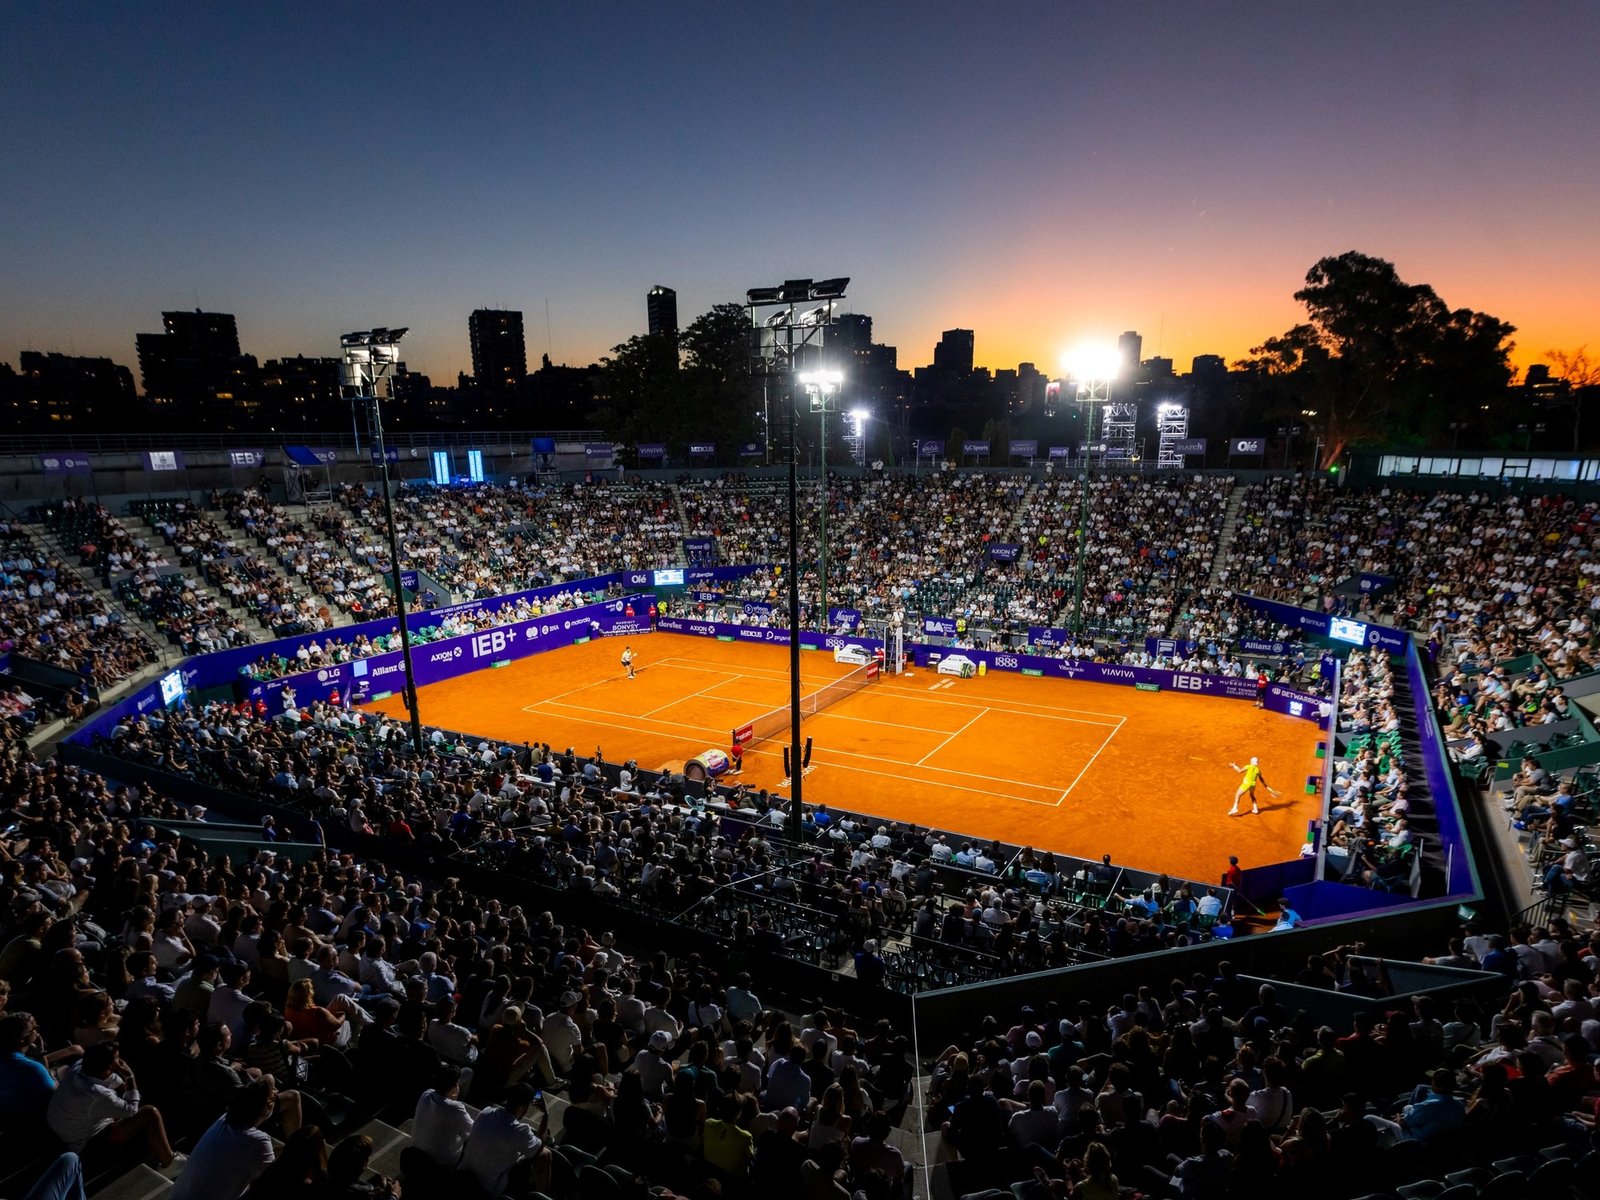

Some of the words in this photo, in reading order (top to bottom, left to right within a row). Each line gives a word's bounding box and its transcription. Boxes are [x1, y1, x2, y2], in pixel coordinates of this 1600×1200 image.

[1237, 441, 1257, 451] Olé
[231, 452, 262, 465] IEB+
[631, 574, 647, 584] Olé
[700, 593, 716, 601] IEB+
[740, 630, 763, 638] MEDICUS
[471, 628, 517, 658] IEB+
[826, 638, 844, 649] 1888
[1245, 642, 1271, 651] Allianz
[431, 650, 453, 662] AXION
[995, 657, 1018, 668] 1888
[328, 668, 340, 678] LG
[372, 665, 398, 677] Allianz
[1101, 668, 1135, 678] VIAVIVA
[1172, 675, 1213, 690] IEB+
[1281, 691, 1325, 706] BETWARRIO
